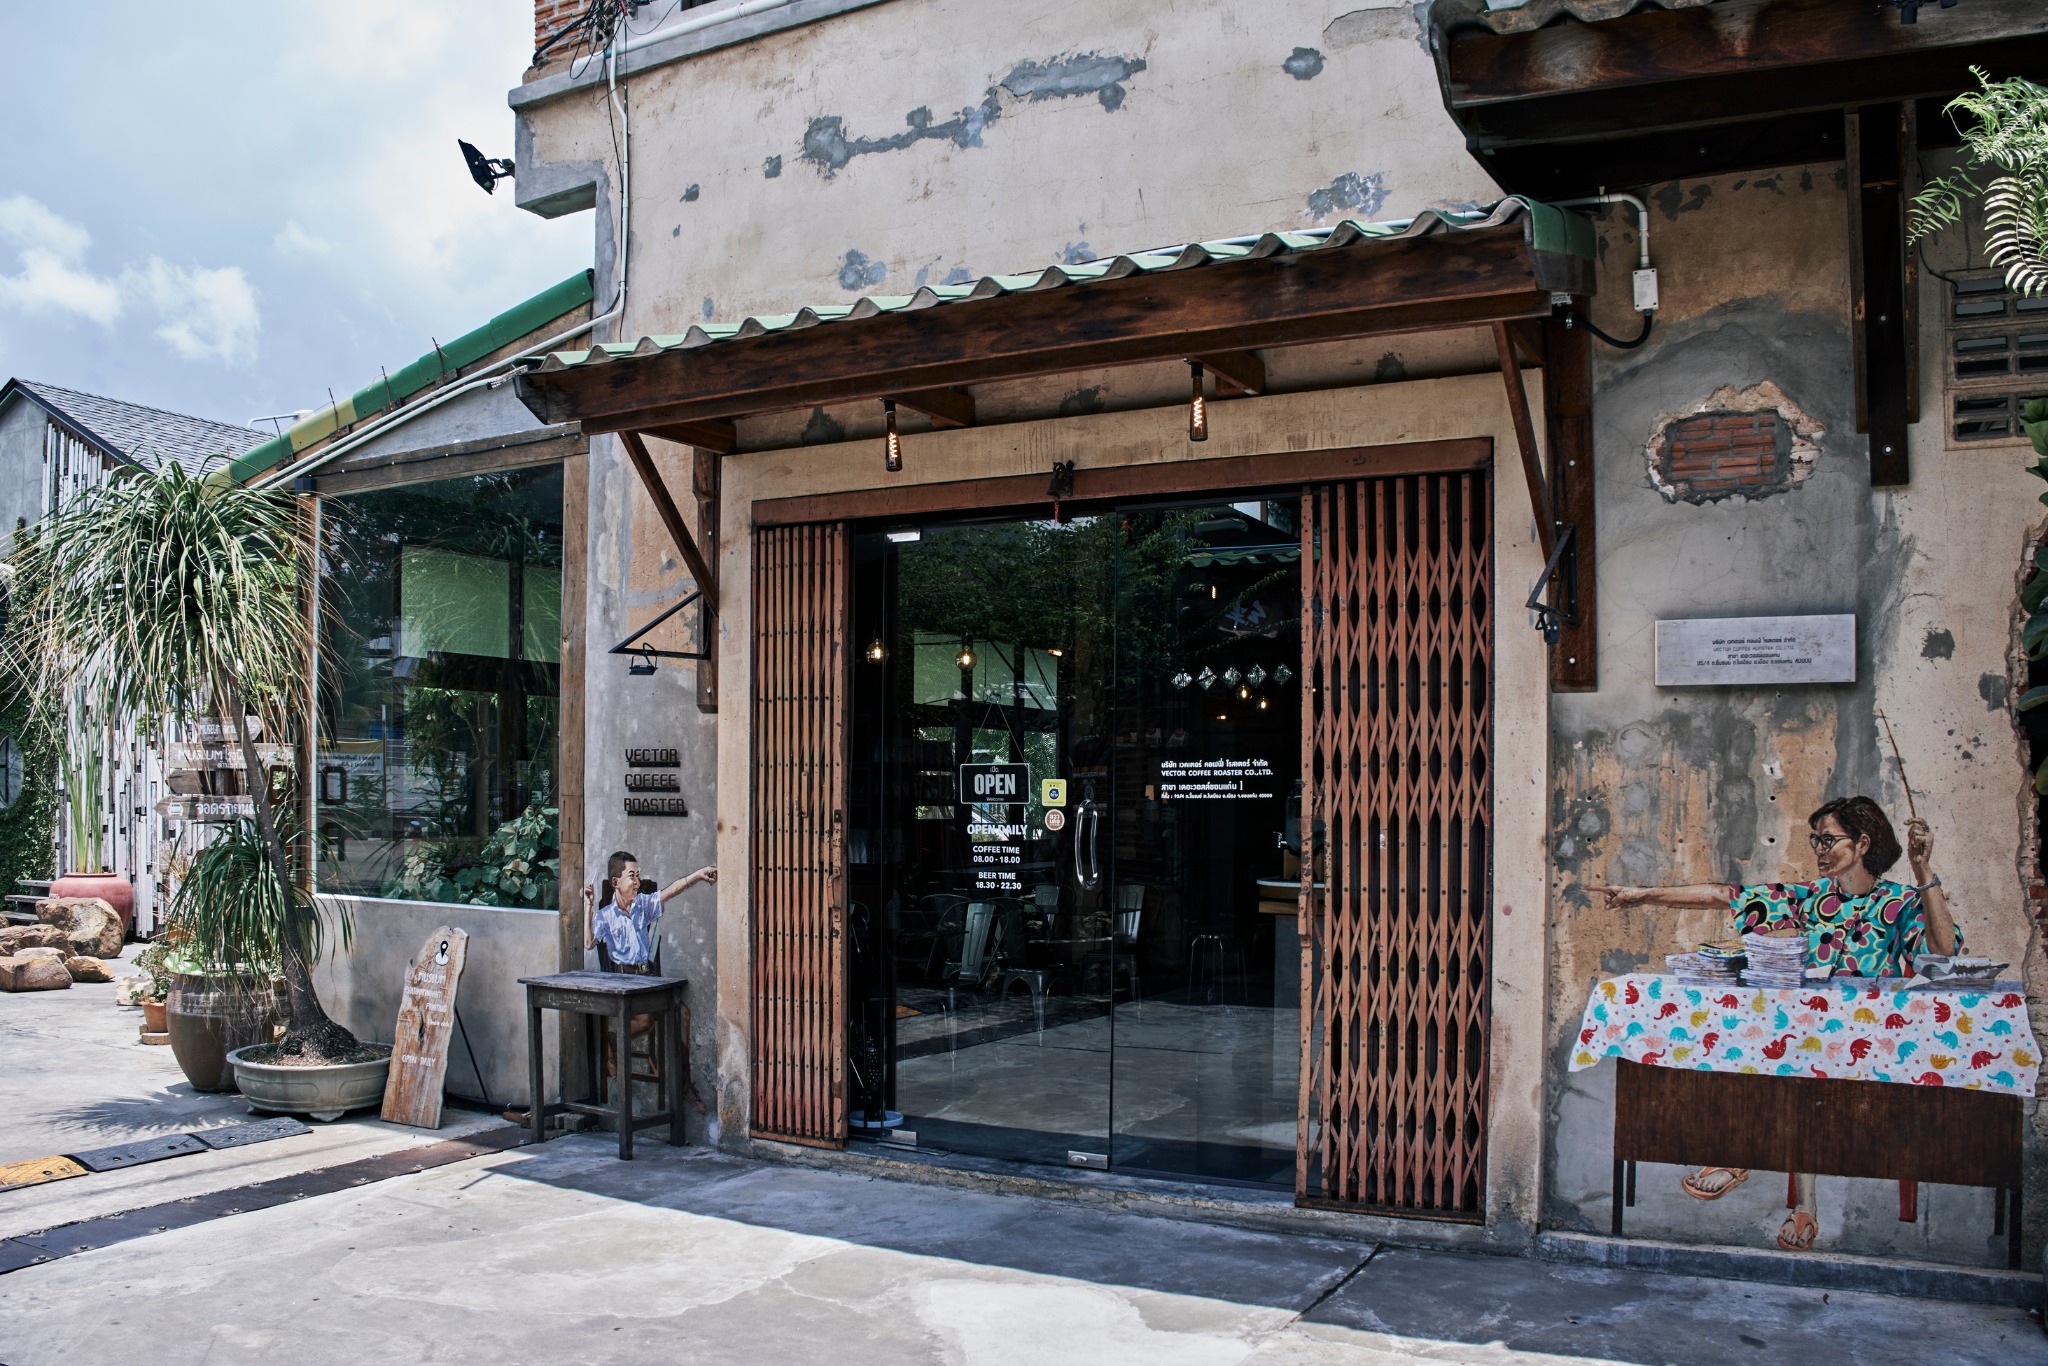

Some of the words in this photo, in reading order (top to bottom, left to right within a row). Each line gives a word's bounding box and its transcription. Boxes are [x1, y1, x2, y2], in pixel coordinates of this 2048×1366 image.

[625, 749, 678, 761] VECTOR
[625, 774, 676, 787] COFFEE
[974, 774, 1016, 795] OPEN
[624, 798, 685, 811] ROASTER
[967, 824, 996, 835] OPEN
[1000, 824, 1028, 835] DAILY
[973, 845, 1000, 853] COFFEE
[1002, 846, 1020, 854] TIME
[418, 971, 447, 984] MUSEUM
[402, 1054, 417, 1063] OPEN
